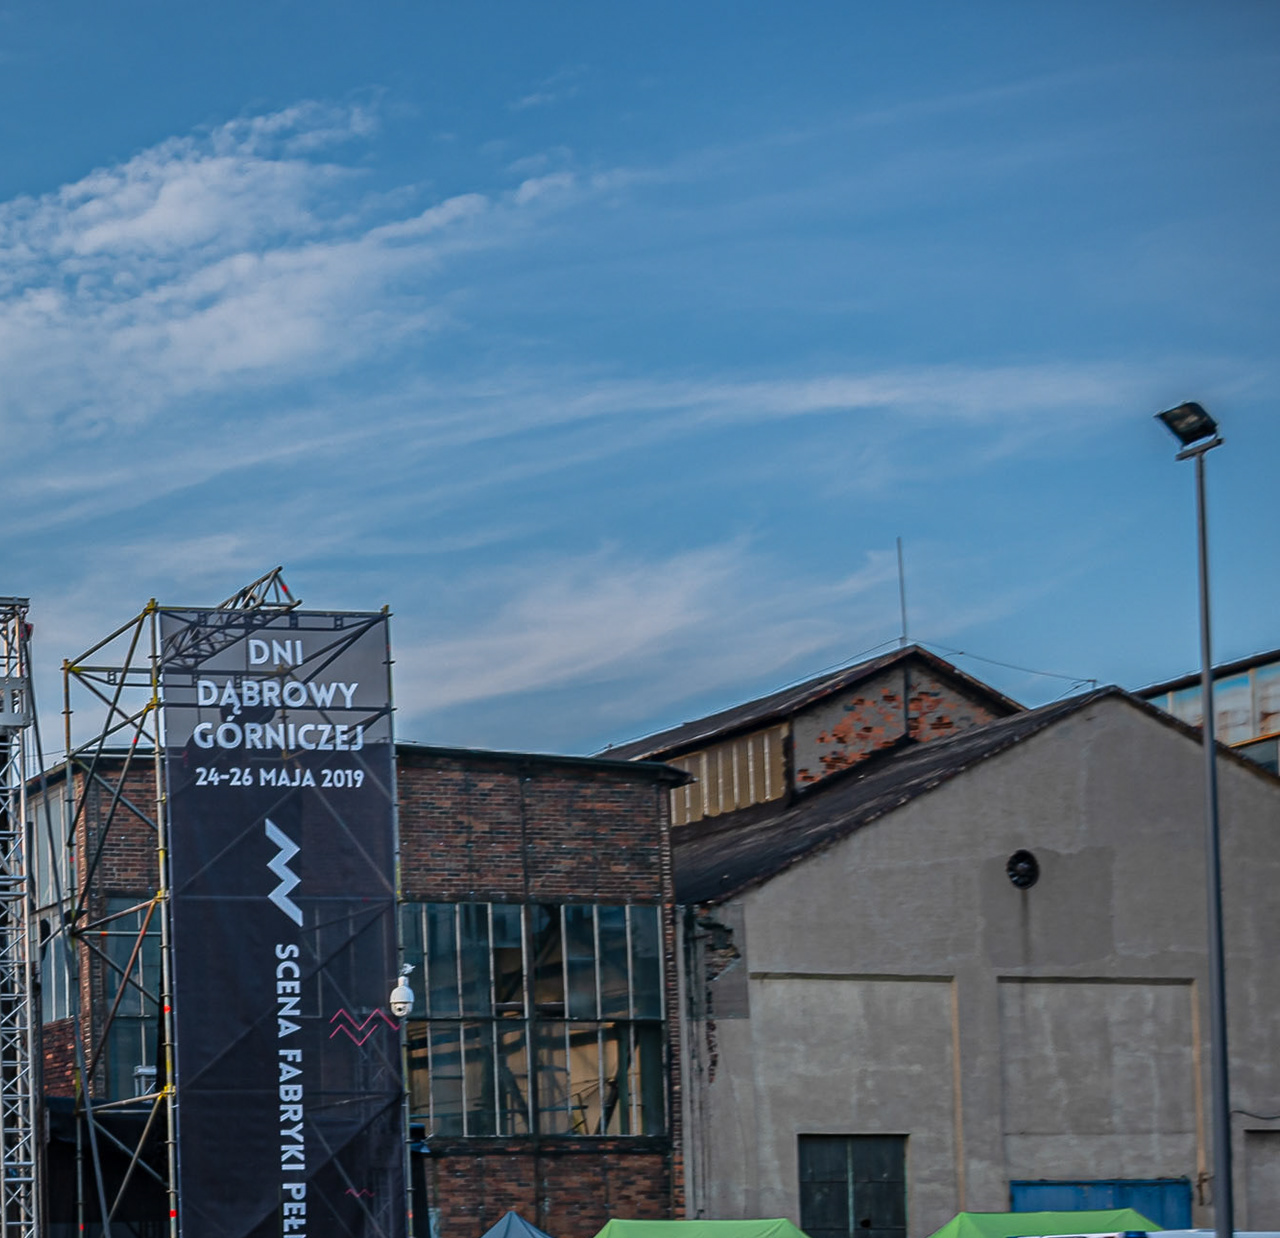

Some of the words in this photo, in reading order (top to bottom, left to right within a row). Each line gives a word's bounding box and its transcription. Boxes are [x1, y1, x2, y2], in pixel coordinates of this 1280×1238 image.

[248, 639, 303, 665] DNI
[197, 680, 359, 716] DĄBROWY
[193, 716, 364, 751] GÓRNICZEJ
[195, 767, 253, 787] 24-26
[259, 768, 316, 788] MAJA
[321, 769, 365, 788] 2019
[275, 943, 303, 1038] SCENA
[278, 1049, 306, 1171] FABRYKI
